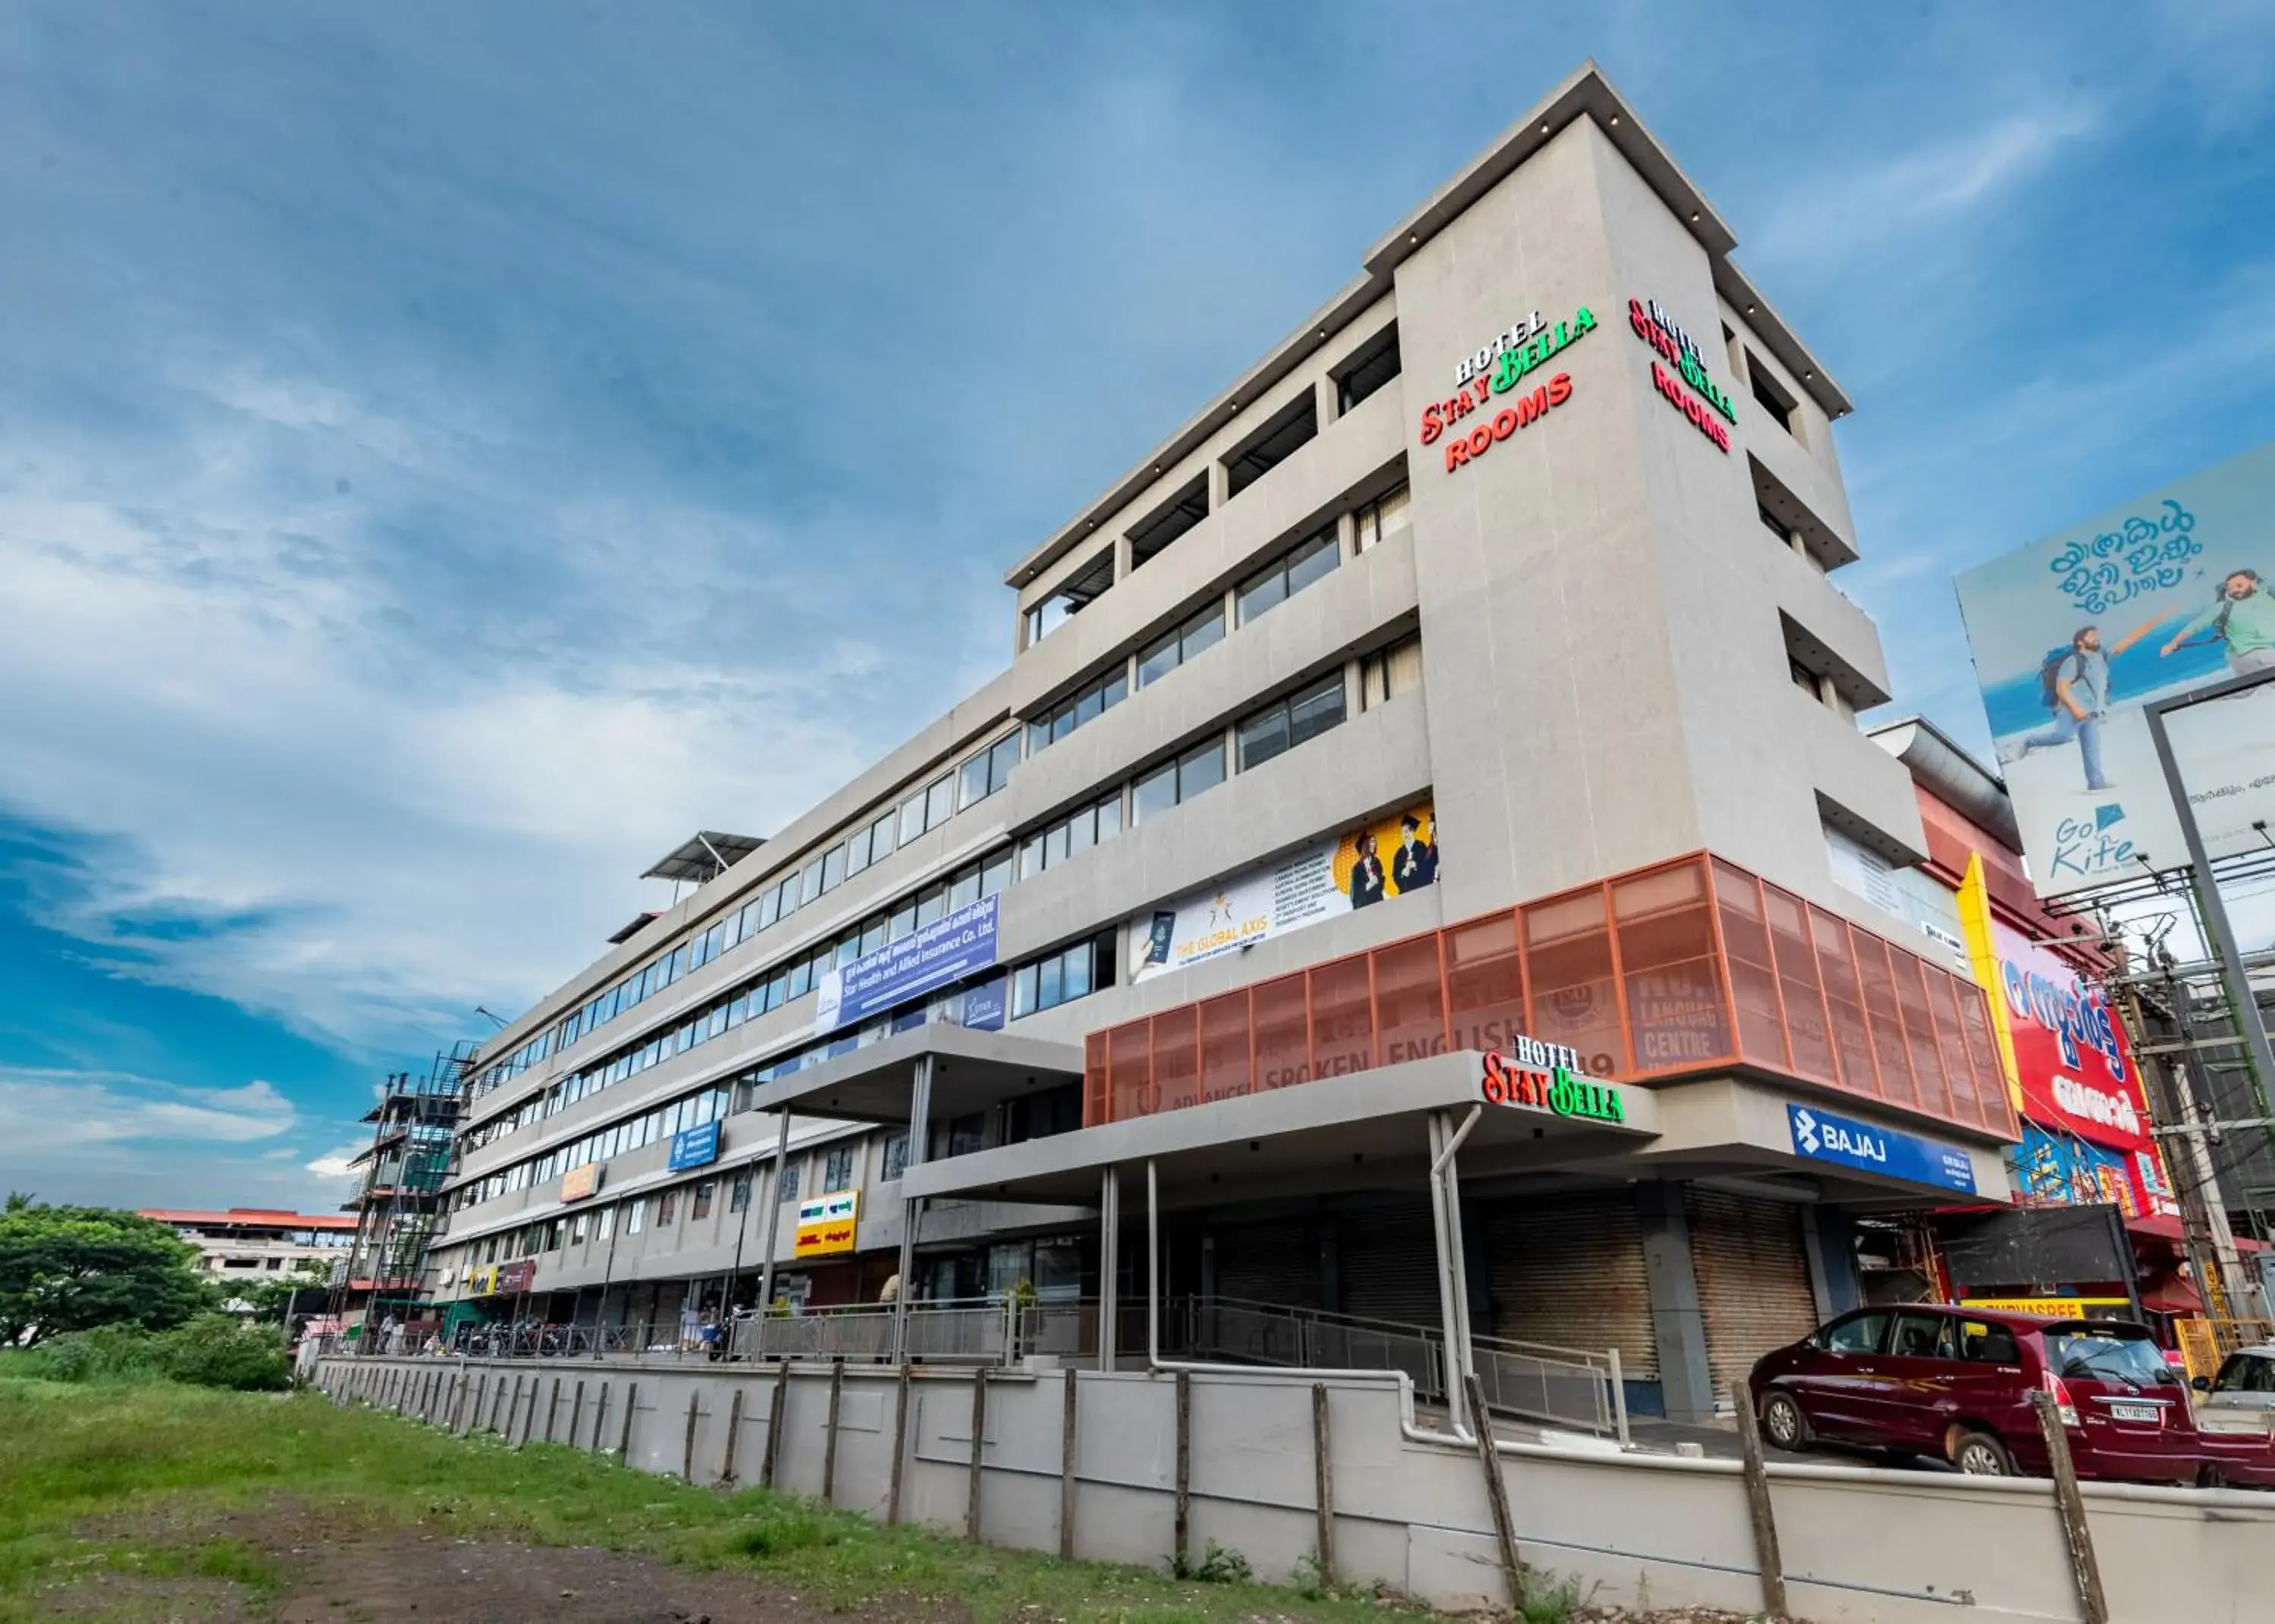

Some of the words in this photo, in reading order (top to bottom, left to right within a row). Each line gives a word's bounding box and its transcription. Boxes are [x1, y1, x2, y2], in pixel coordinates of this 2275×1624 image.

[1454, 309, 1547, 388] HOTEL
[1649, 298, 1707, 372] HOTEL
[1444, 372, 1574, 473] ROOMS
[1650, 361, 1732, 453] ROOMS
[2056, 817, 2093, 843] Go
[2050, 840, 2135, 878] Kite
[921, 937, 961, 961] Insurance
[1197, 926, 1238, 950] GLOBAL
[1241, 914, 1267, 936] AXIS
[1515, 1034, 1584, 1075] HOTEL
[1644, 1031, 1713, 1058] CENTRE
[1266, 1049, 1369, 1089] SPOKEN
[1822, 1124, 1886, 1162] BAJAJ
